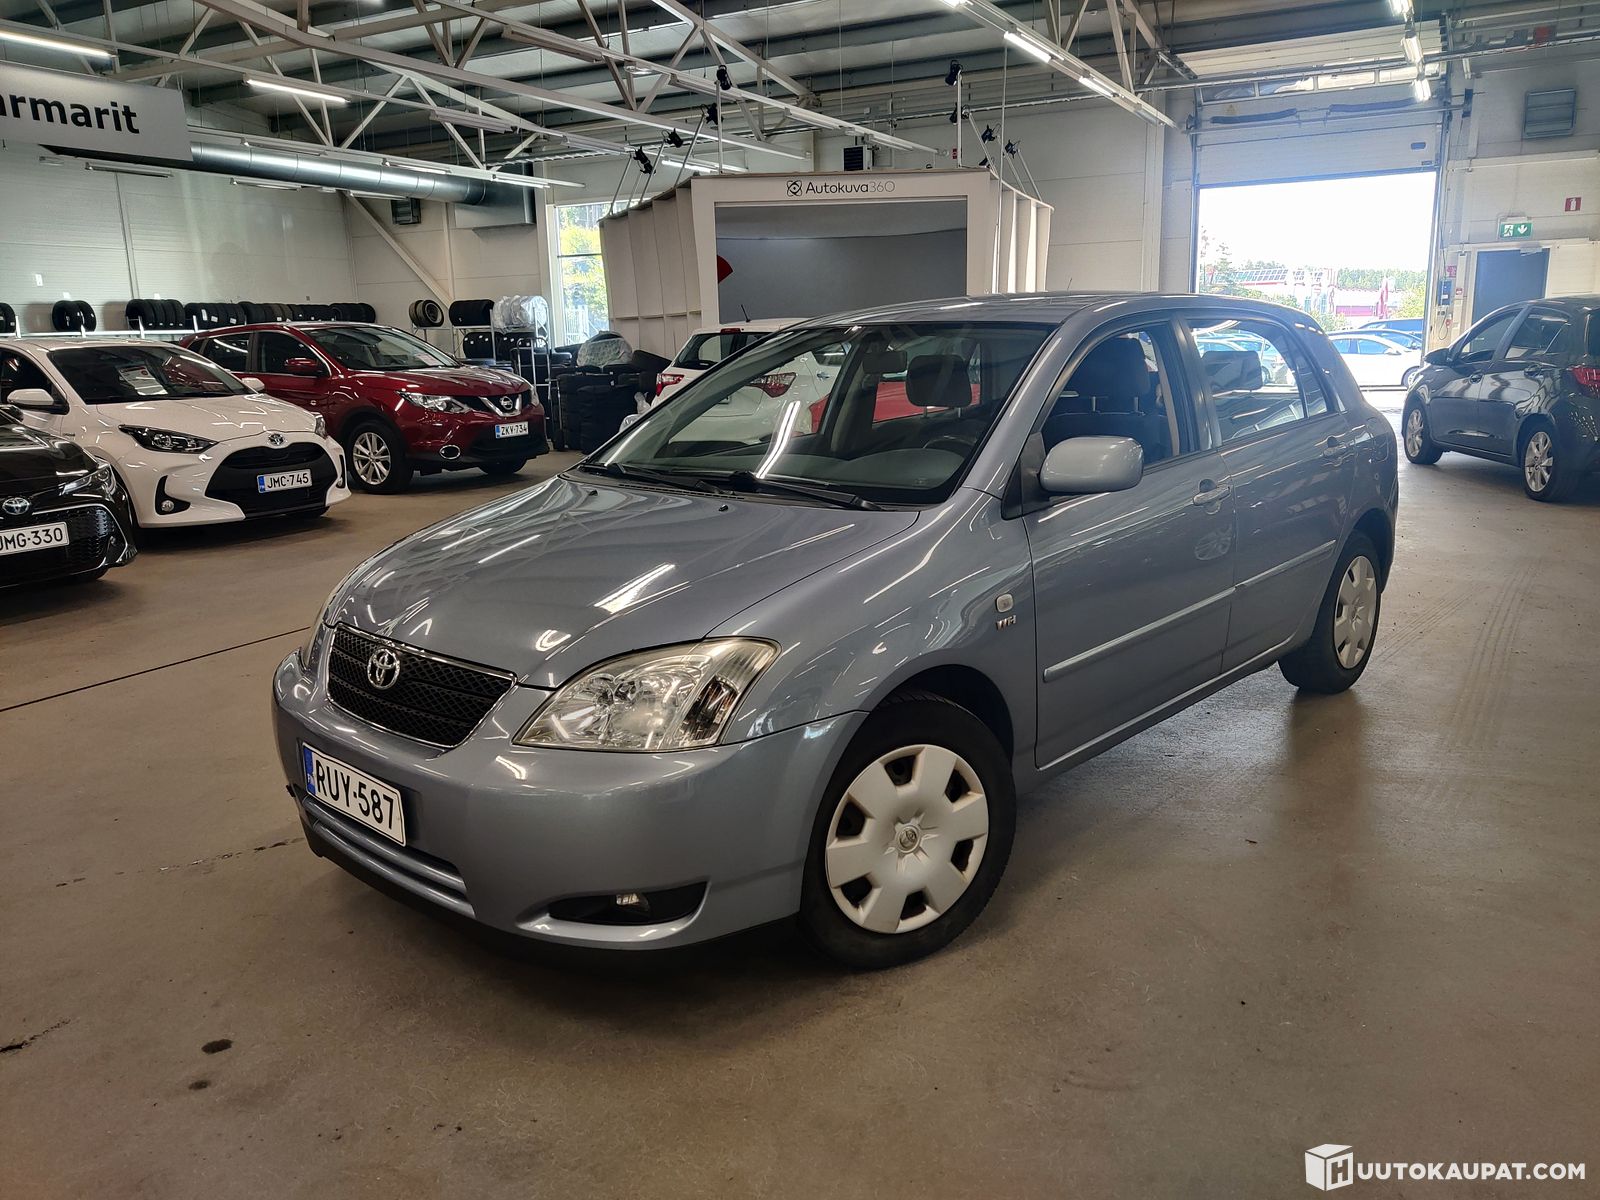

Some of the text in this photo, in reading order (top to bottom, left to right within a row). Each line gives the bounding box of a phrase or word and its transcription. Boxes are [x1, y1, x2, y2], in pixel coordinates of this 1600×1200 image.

[805, 181, 896, 194] Autokuva360
[501, 424, 527, 435] ZKV-734
[267, 473, 309, 488] JMC-745
[315, 759, 394, 830] RUY-587
